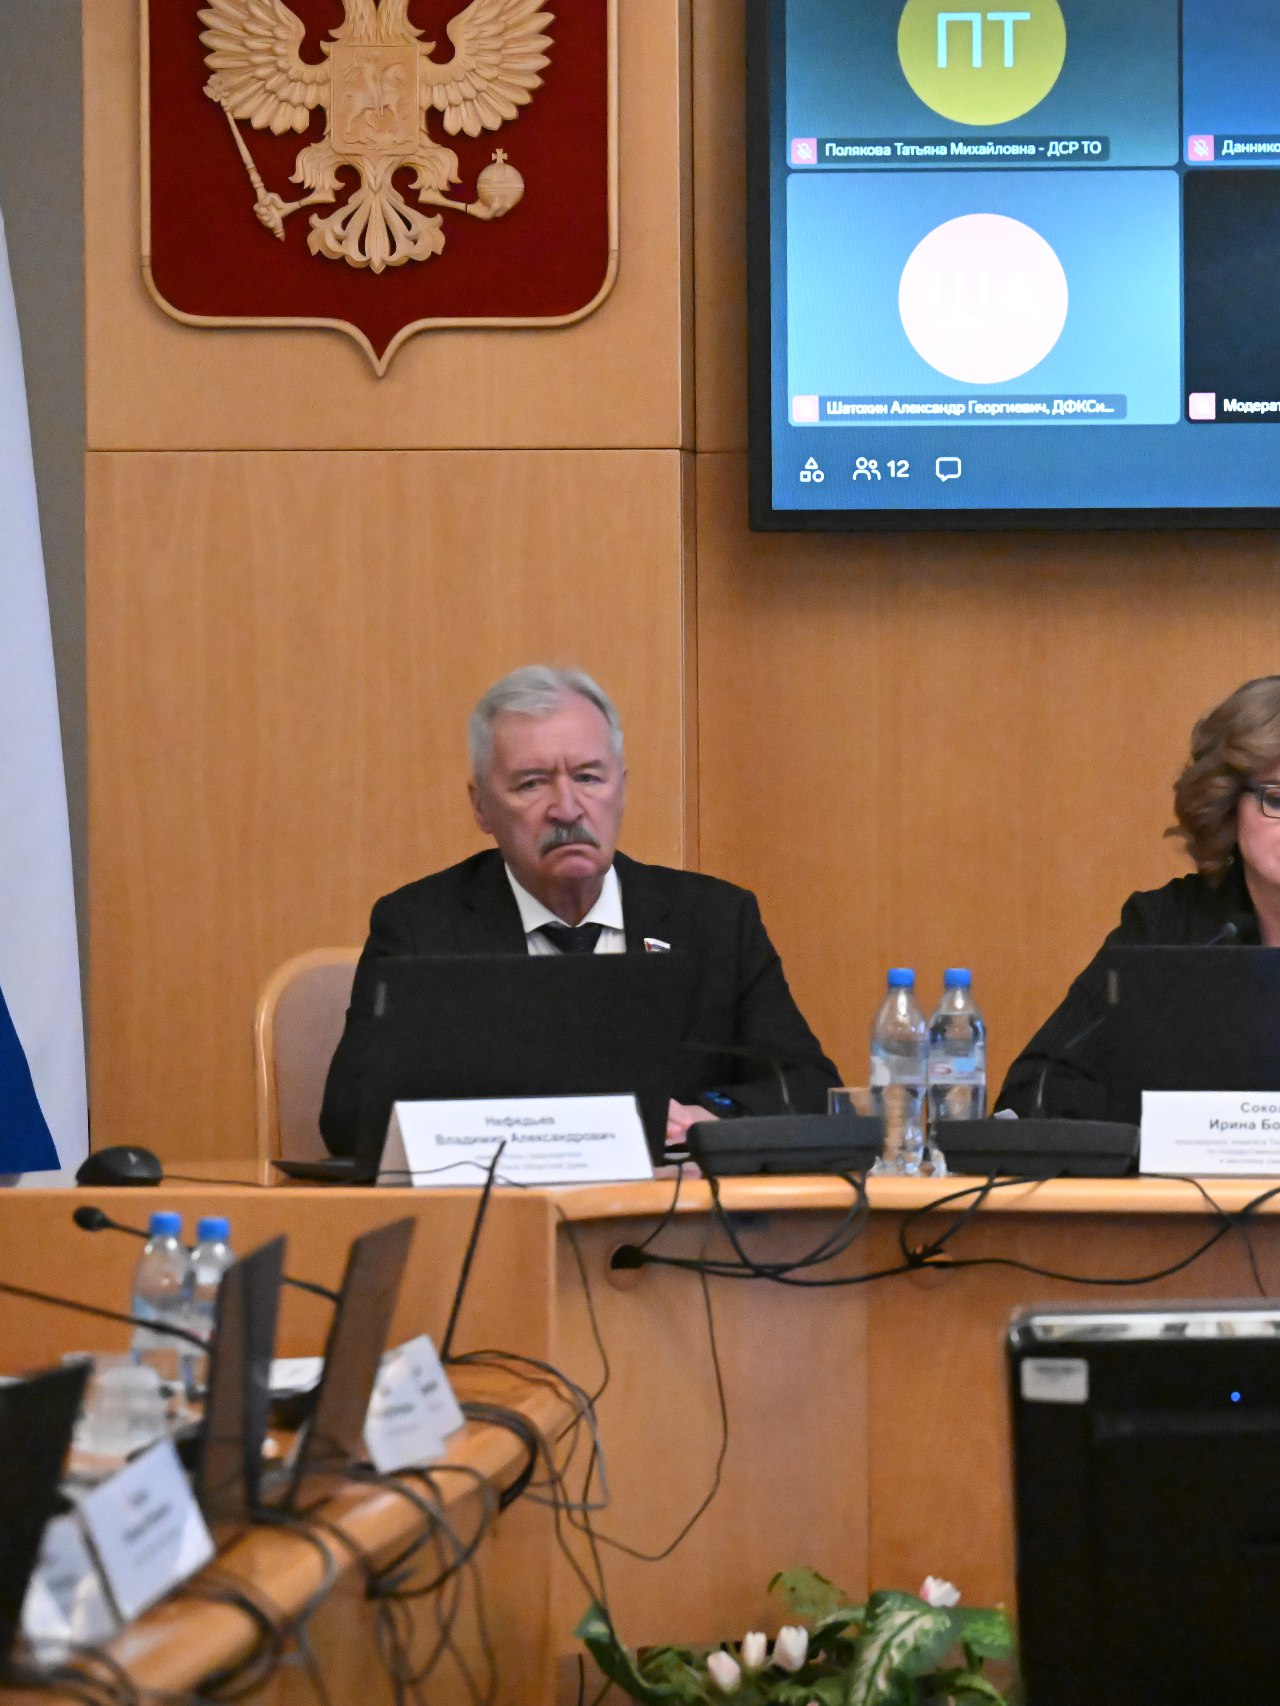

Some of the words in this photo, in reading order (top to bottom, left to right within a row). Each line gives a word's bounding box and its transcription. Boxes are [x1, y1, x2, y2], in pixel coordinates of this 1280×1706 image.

[937, 12, 1030, 68] ПТ
[825, 143, 891, 158] Полякова
[894, 142, 947, 156] Татьяна
[950, 141, 1035, 156] Михайловна
[1047, 141, 1078, 157] ДСР
[1081, 141, 1102, 154] ТО
[826, 401, 888, 415] Шатохин
[890, 401, 964, 417] Александр
[886, 459, 910, 478] 12
[1209, 1118, 1256, 1132] Ирина
[510, 1131, 616, 1146] Александрович
